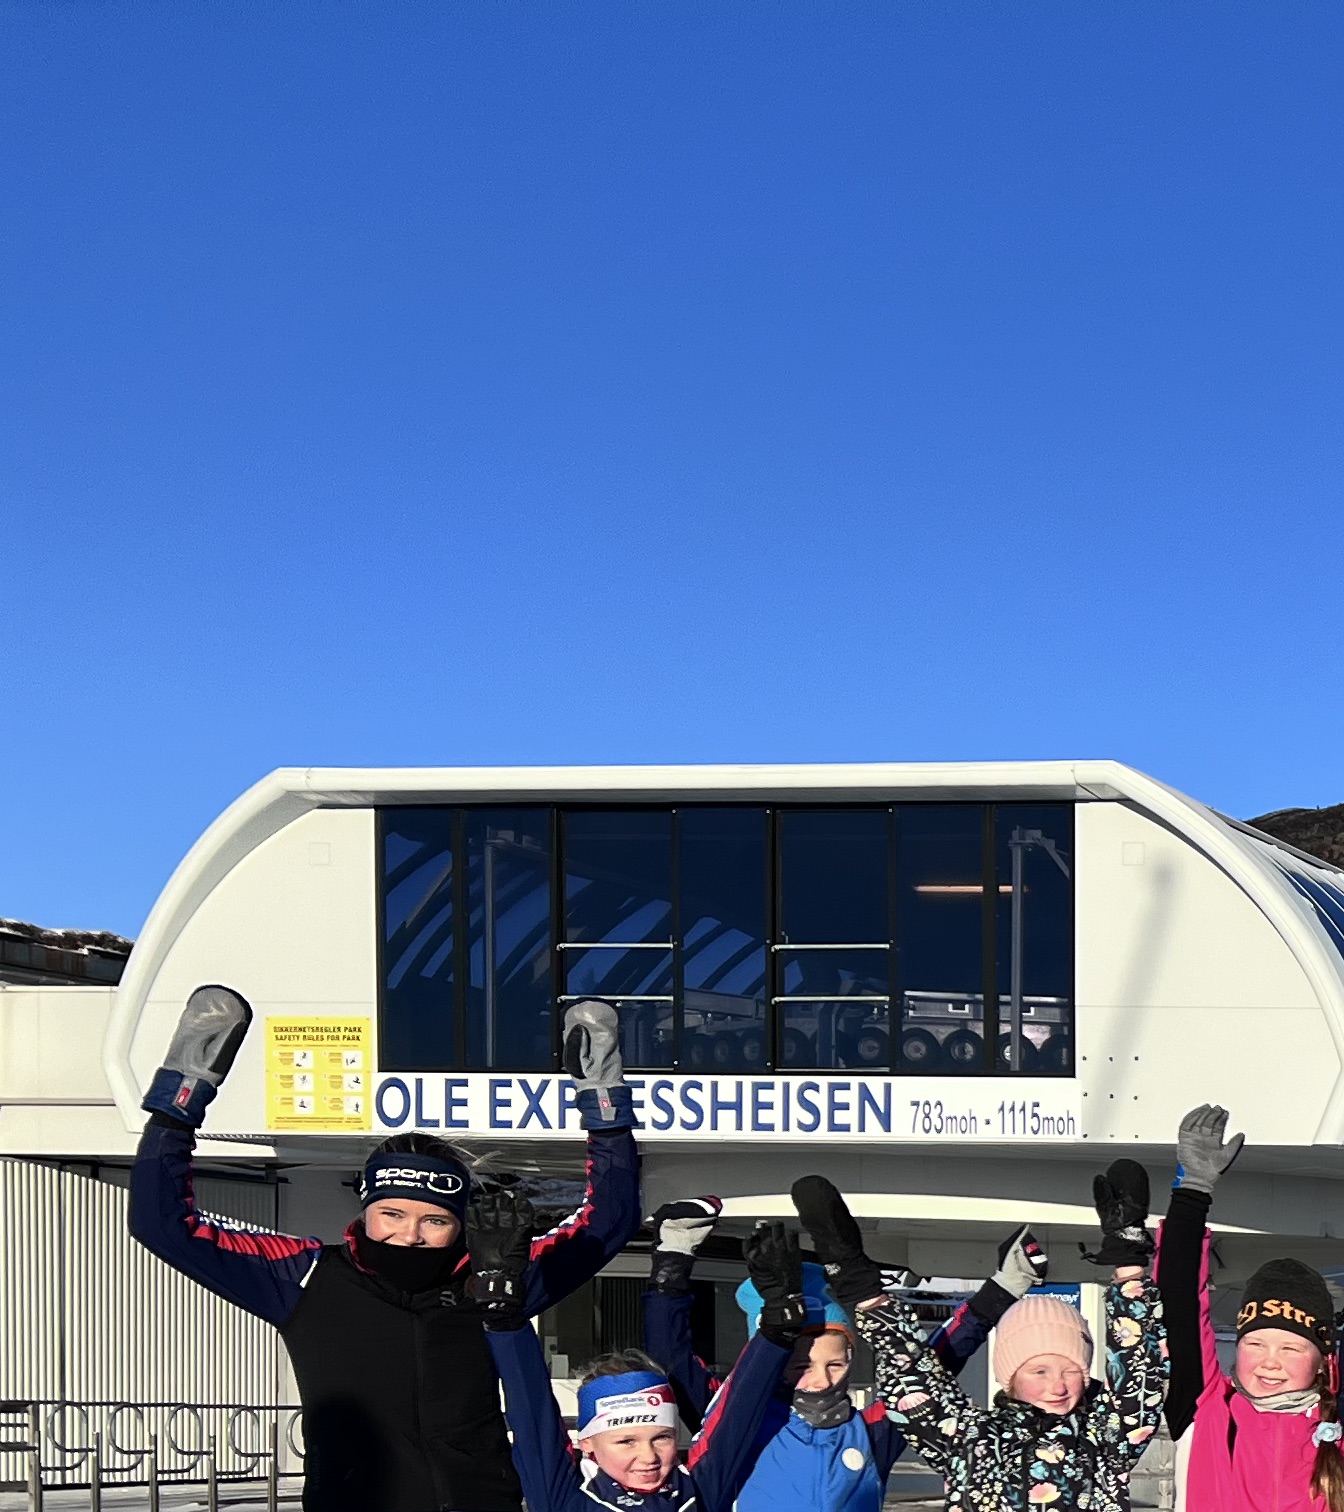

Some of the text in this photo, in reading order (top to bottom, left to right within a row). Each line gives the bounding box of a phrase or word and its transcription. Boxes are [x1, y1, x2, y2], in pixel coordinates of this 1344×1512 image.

[375, 1076, 470, 1129] OLE
[910, 1100, 977, 1135] 783moh
[997, 1101, 1076, 1136] 1115moh
[375, 1168, 438, 1182] sport
[606, 1414, 658, 1428] TRIMTEX
